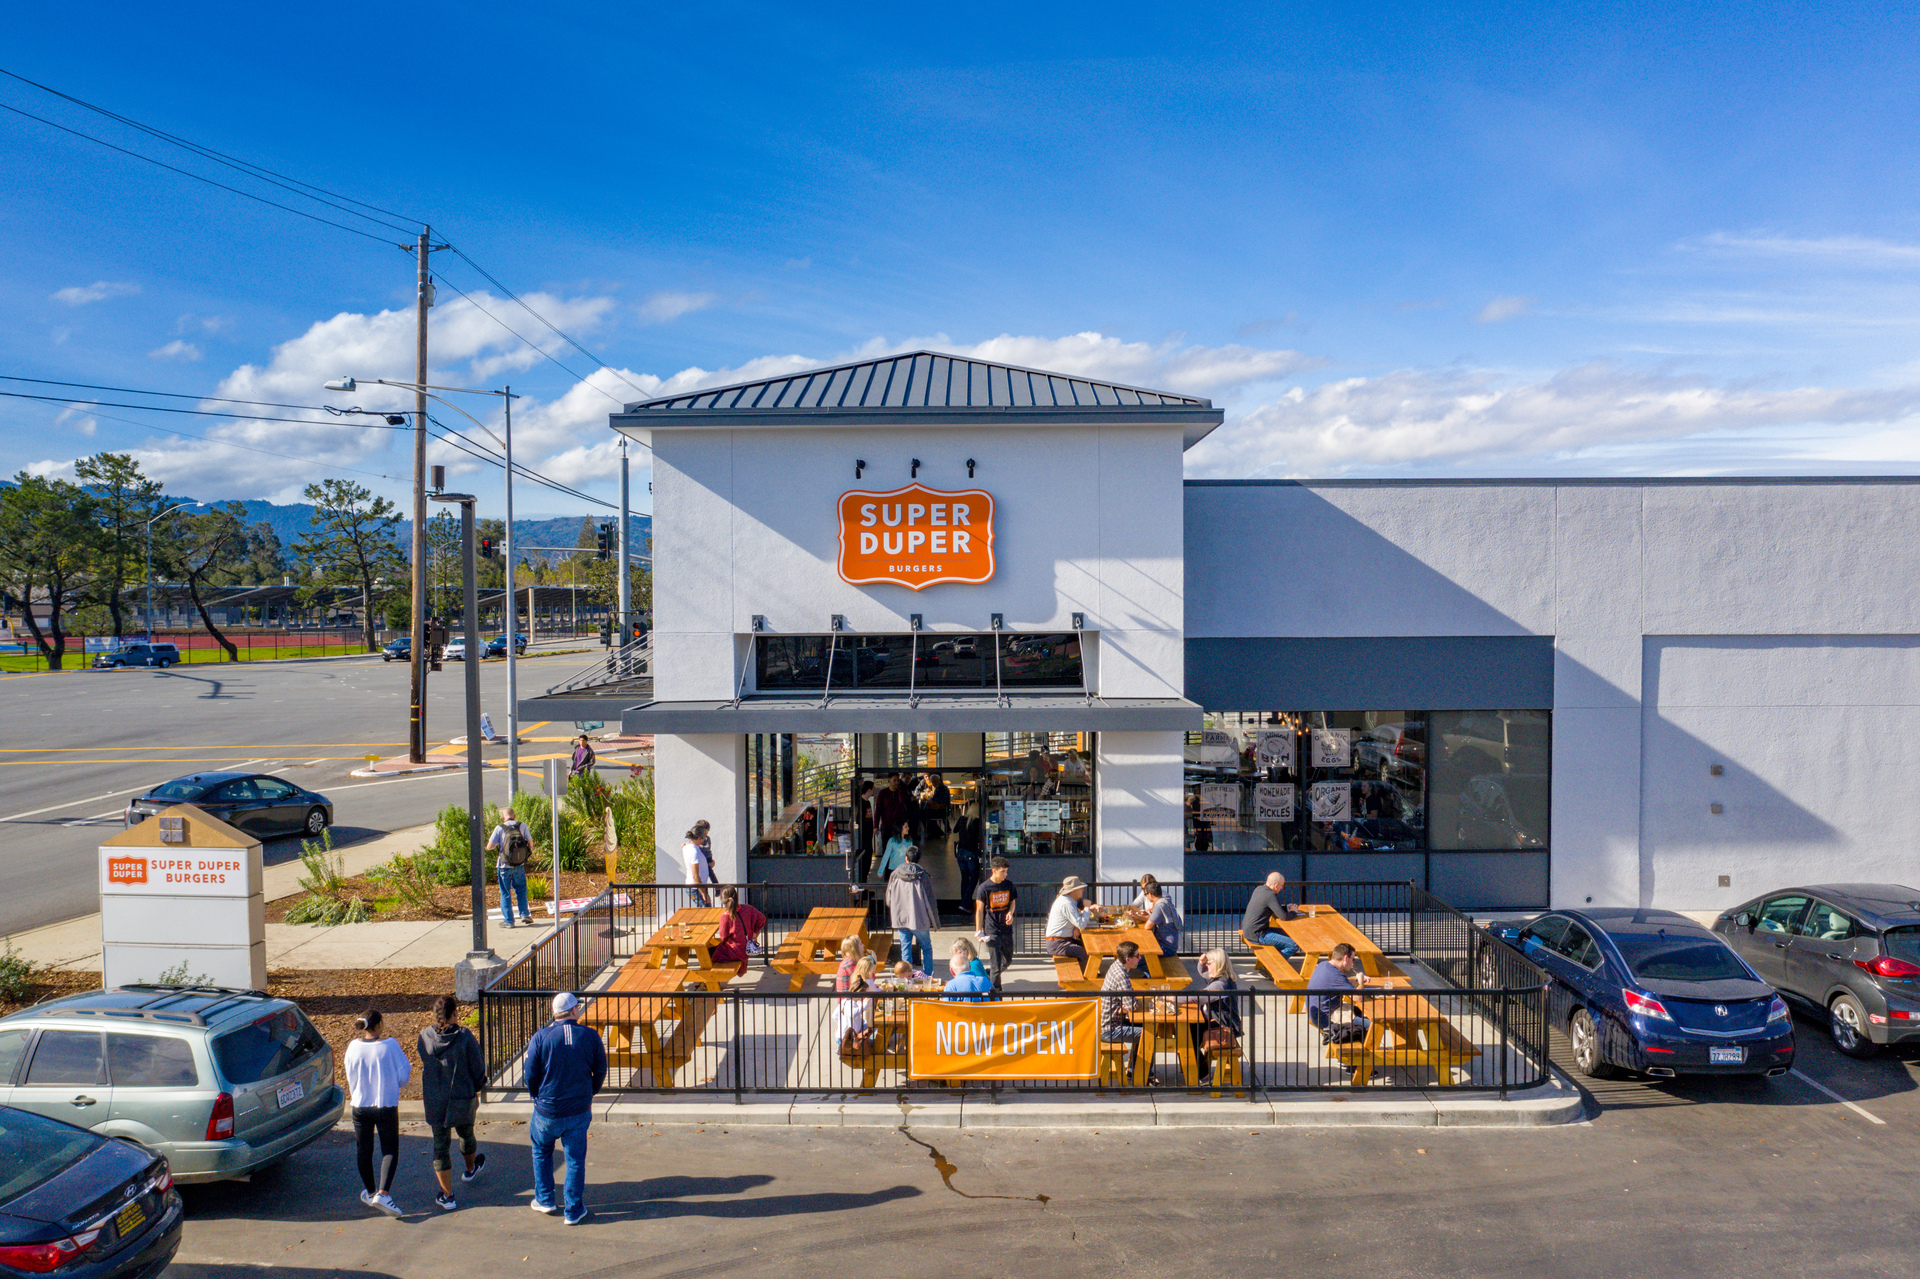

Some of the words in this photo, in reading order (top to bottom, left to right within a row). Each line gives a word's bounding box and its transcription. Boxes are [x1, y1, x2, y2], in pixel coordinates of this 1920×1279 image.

[860, 503, 971, 527] SUPER
[860, 530, 971, 555] DUPER
[889, 565, 943, 573] BURGERS
[1314, 730, 1348, 741] ORGANIC
[900, 744, 940, 756] 5399
[1259, 787, 1291, 798] HOMEMADE
[1315, 786, 1348, 801] ORGANIC
[1259, 806, 1291, 817] PICKLES
[151, 860, 192, 870] SUPER
[198, 861, 240, 870] DUPER
[166, 873, 226, 884] BURGERS
[936, 1021, 995, 1056] NOW
[1003, 1020, 1074, 1056] OPEN!
